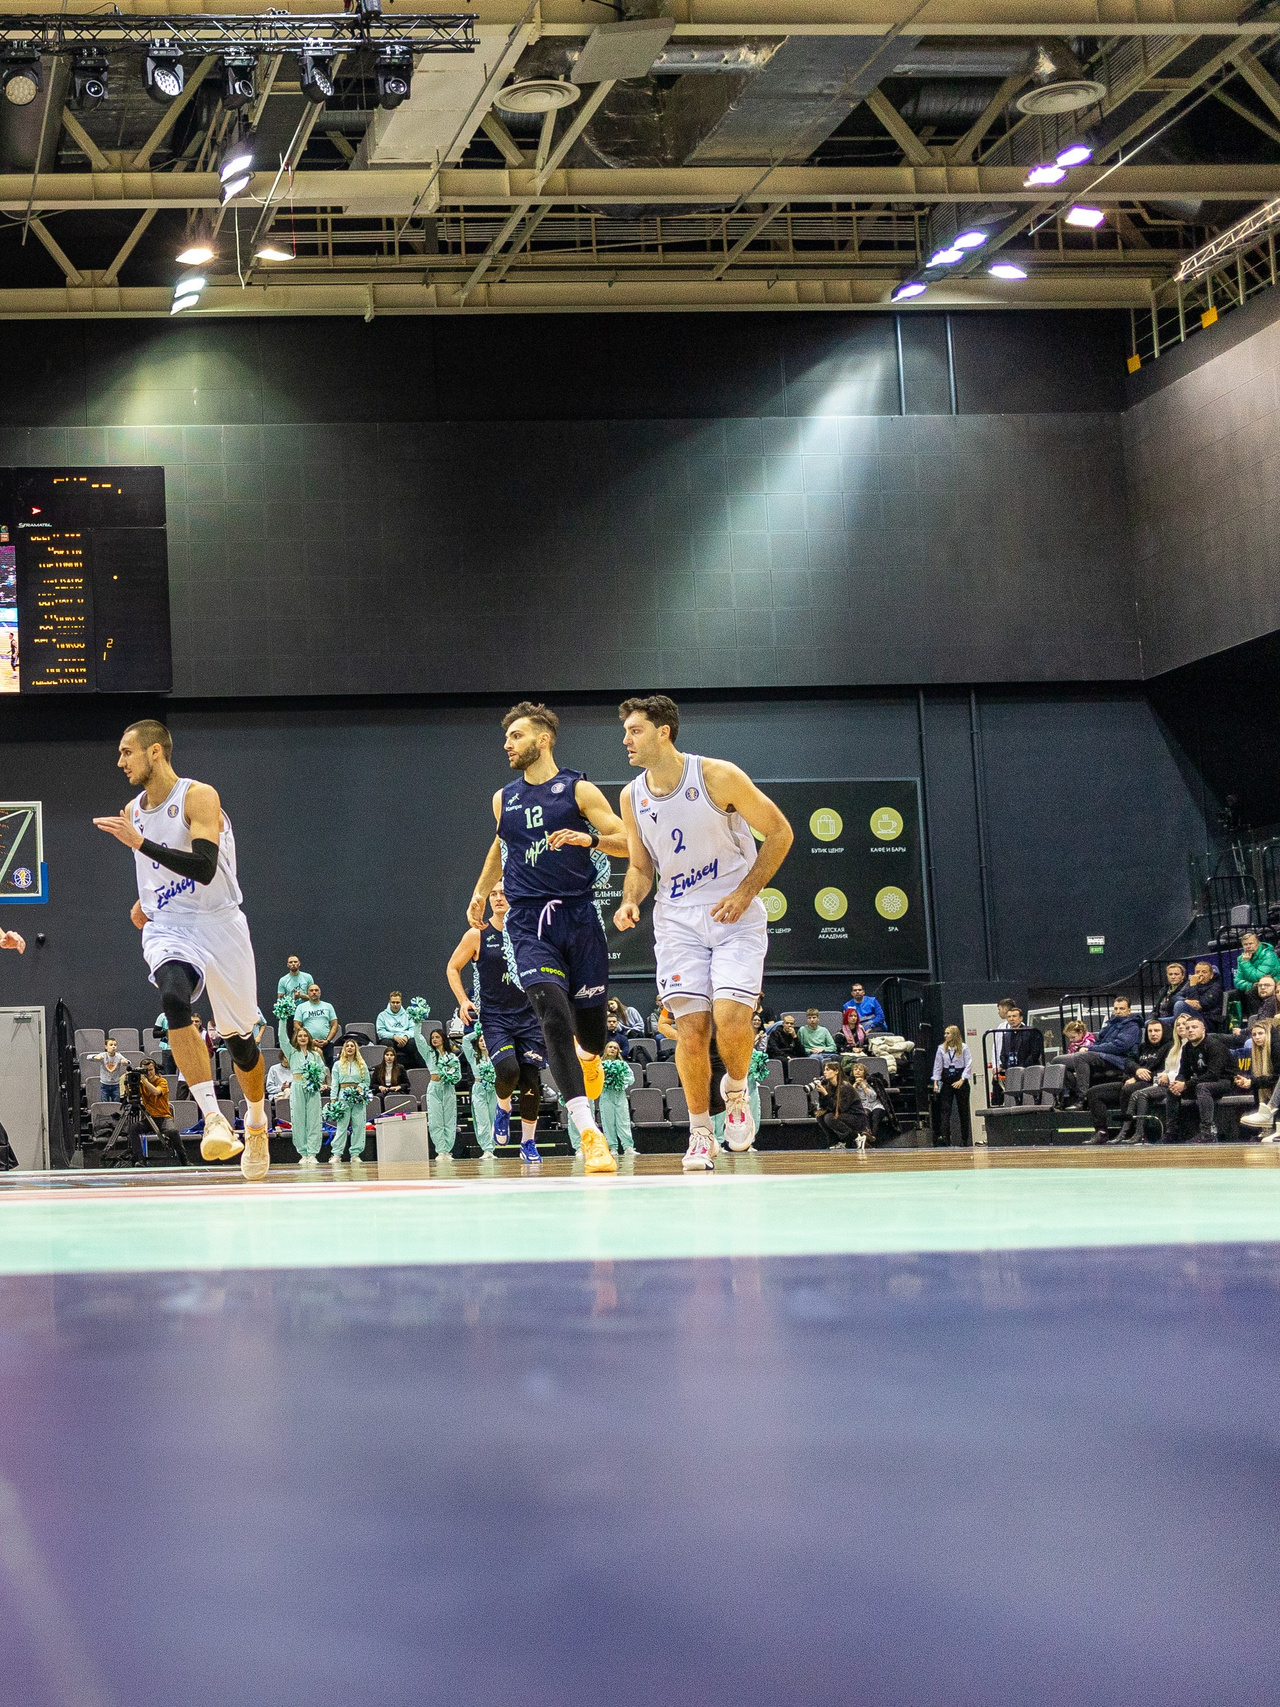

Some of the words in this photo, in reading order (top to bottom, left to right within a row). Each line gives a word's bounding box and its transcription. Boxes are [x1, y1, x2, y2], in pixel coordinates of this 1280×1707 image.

[524, 805, 544, 829] 12
[671, 828, 686, 854] 2
[670, 858, 718, 898] Enisey
